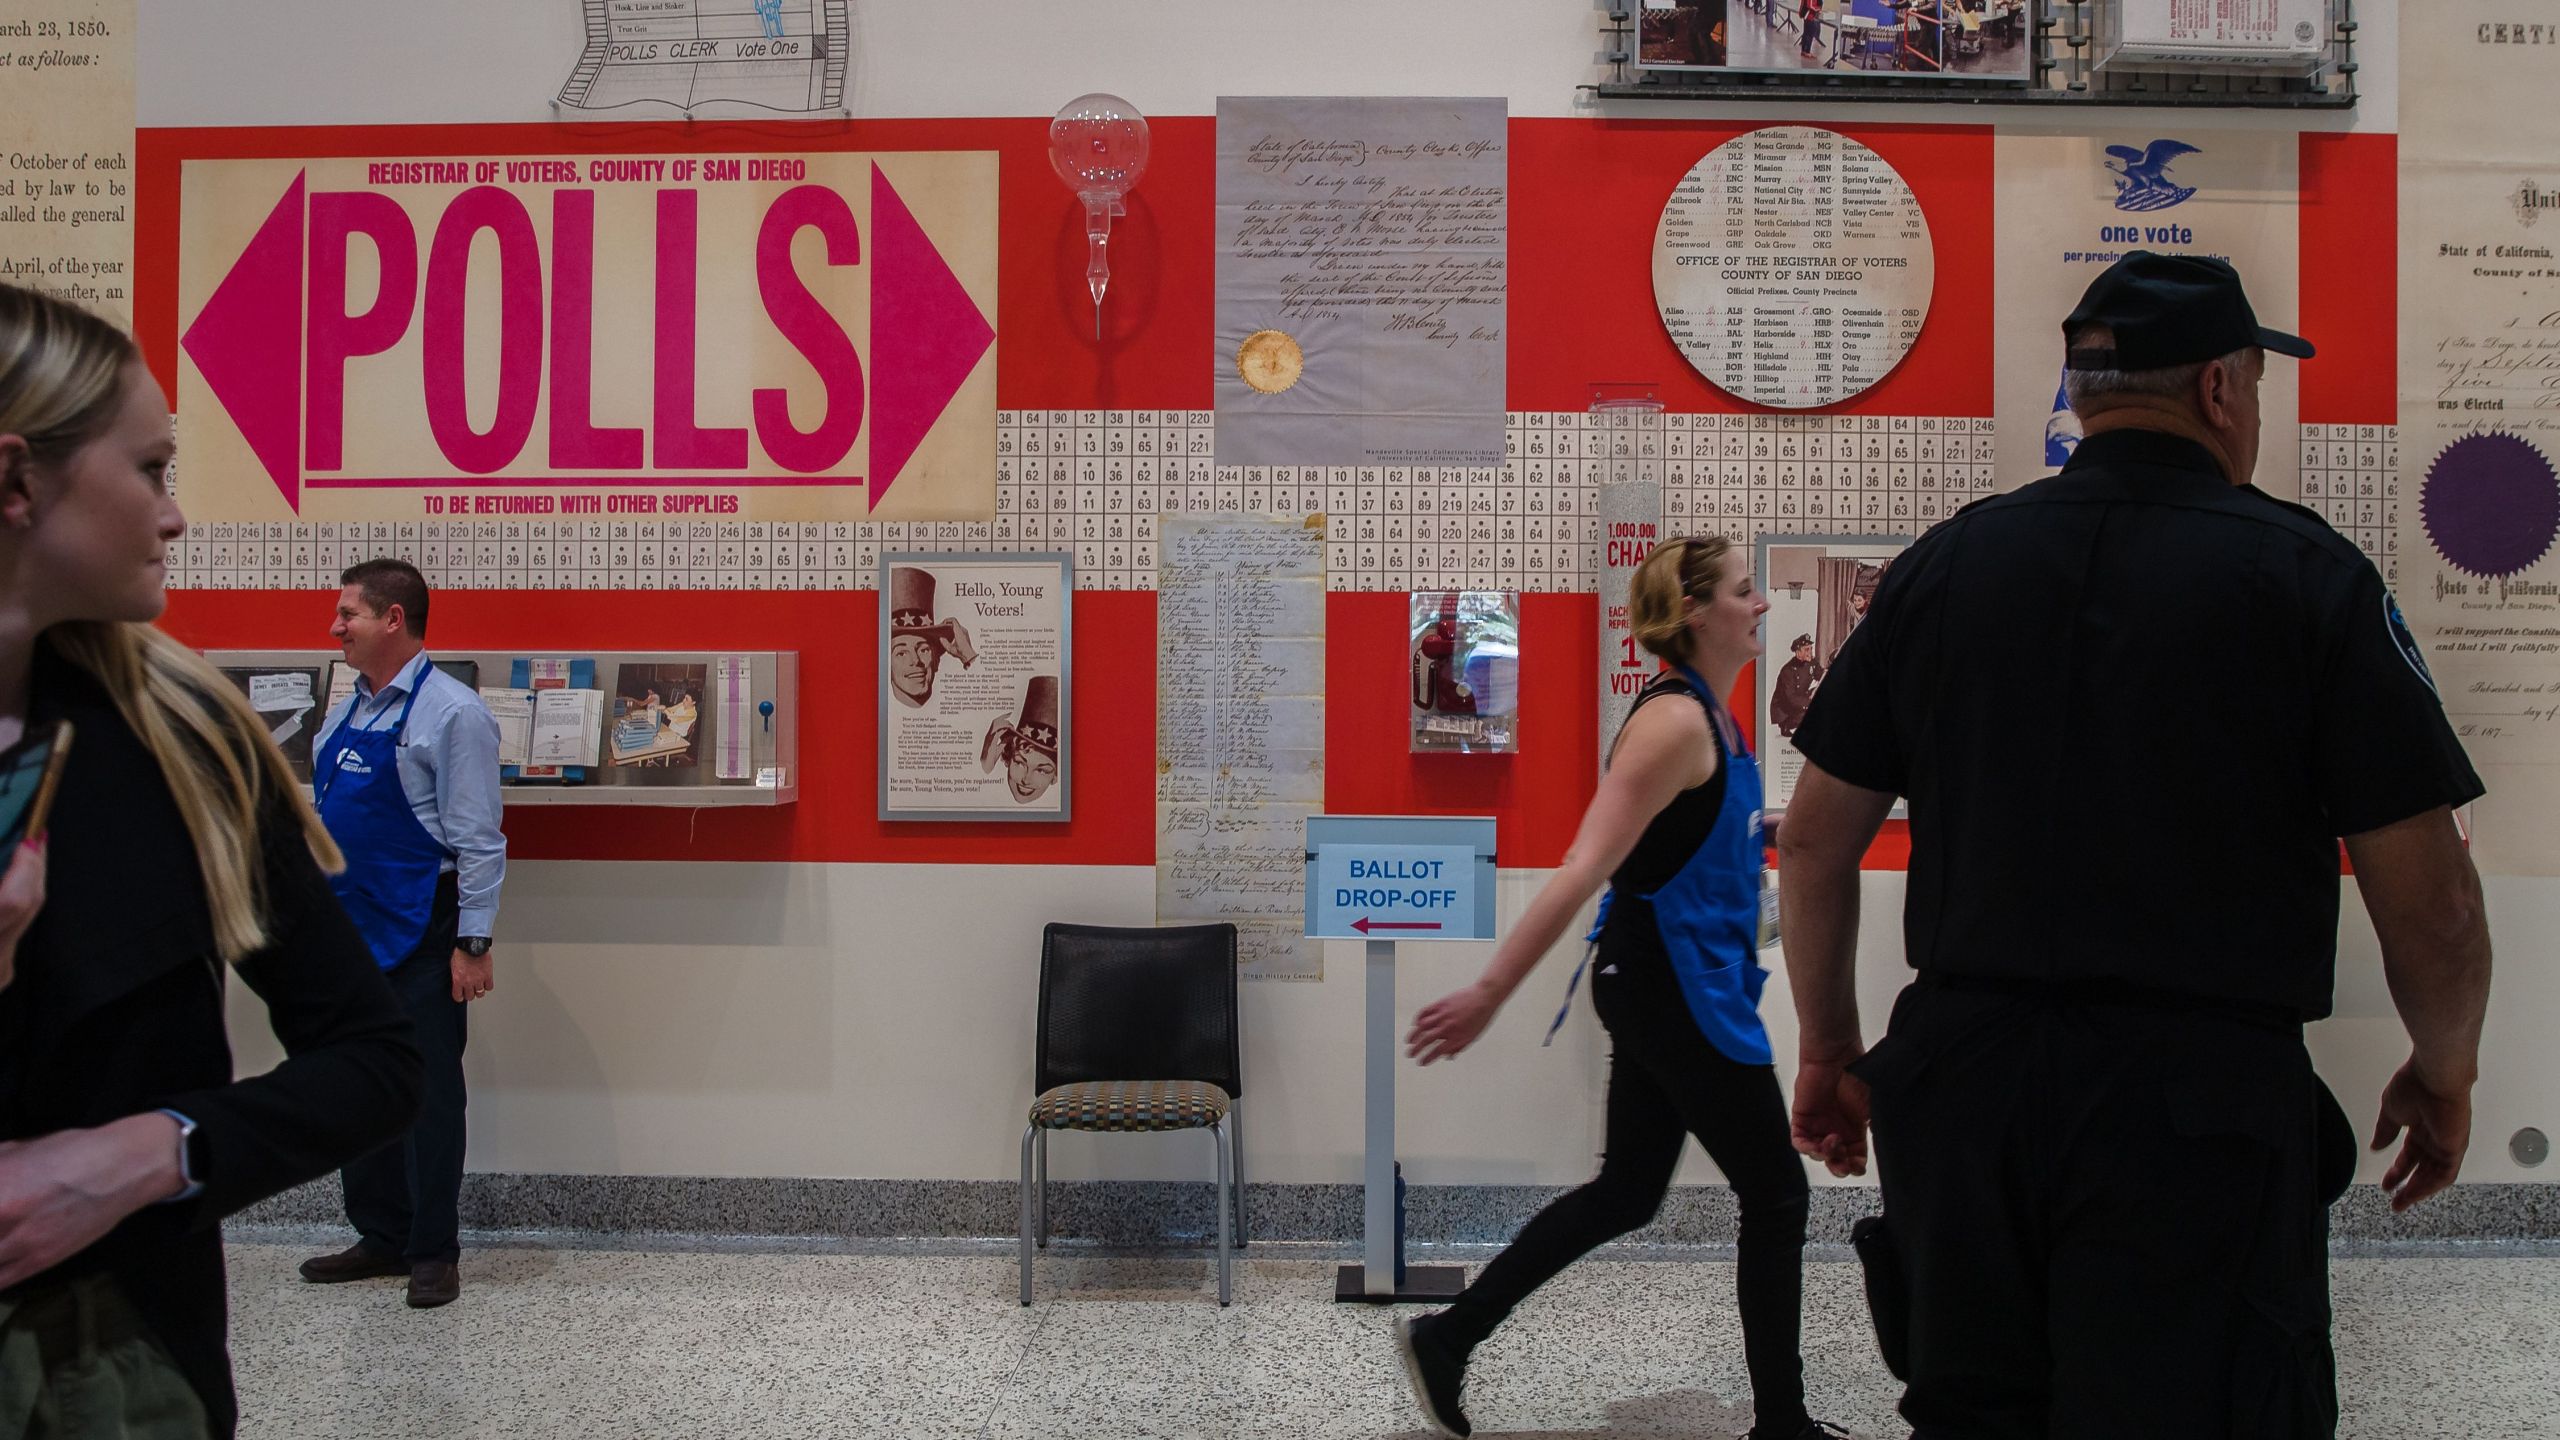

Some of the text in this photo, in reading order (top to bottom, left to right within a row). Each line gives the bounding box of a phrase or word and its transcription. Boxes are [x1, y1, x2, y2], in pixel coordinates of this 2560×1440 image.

[38, 21, 61, 40] 23,
[68, 20, 110, 36] 1850.
[610, 40, 799, 61] POLLS CLERK Vote One
[18, 54, 35, 66] as
[10, 152, 127, 170] October of each
[368, 158, 806, 185] REGISTRAR OF VOTERS, COUNTY OF SAN DIEGO
[1813, 164, 1832, 172] MSN
[1754, 175, 1832, 184] Murray MRY
[25, 179, 43, 201] by
[50, 179, 76, 196] law
[85, 181, 100, 196] to
[1754, 186, 1832, 195] National City NC
[43, 205, 66, 222] the
[71, 205, 125, 228] general
[1754, 208, 1778, 216] Nestor
[1754, 230, 1832, 238] Oakdale OKD
[2101, 223, 2193, 244] one vote
[2438, 243, 2469, 257] State
[2476, 245, 2487, 257] of
[1676, 256, 1908, 267] OFFICE OF THE REGISTRAR OF VOTERS
[2064, 252, 2124, 264] per precin
[0, 257, 124, 279] April, of the year
[2473, 268, 2523, 278] County
[2528, 269, 2542, 277] of
[1721, 271, 1863, 281] COUNTY OF SAN DIEGO
[106, 287, 124, 299] an
[1726, 287, 1755, 296] Official
[1792, 288, 1820, 297] County
[1822, 288, 1858, 296] Precincts
[305, 185, 865, 474] POLLS
[1753, 342, 1773, 350] Helix
[1754, 386, 1785, 395] Imperial
[2437, 397, 2504, 410] was Elected
[2306, 426, 2374, 438] 90 12 38
[2306, 454, 2375, 467] 91 13 39
[424, 494, 738, 514] TO BE RETURNED WITH OTHER SUPPLIES
[214, 527, 260, 538] 220 246
[1608, 522, 1656, 539] 1,000,000
[954, 582, 1044, 599] Hello, Young
[974, 602, 1024, 617] Voters!
[1608, 606, 1629, 618] EACH
[2444, 627, 2463, 636] will
[2464, 628, 2505, 638] support
[2505, 628, 2519, 636] the
[1621, 635, 1641, 667] 1
[2435, 642, 2455, 651] and
[2456, 642, 2477, 651] that
[2488, 642, 2507, 651] will
[1350, 860, 1443, 879] BALLOT
[1336, 889, 1456, 908] DROP-OFF
